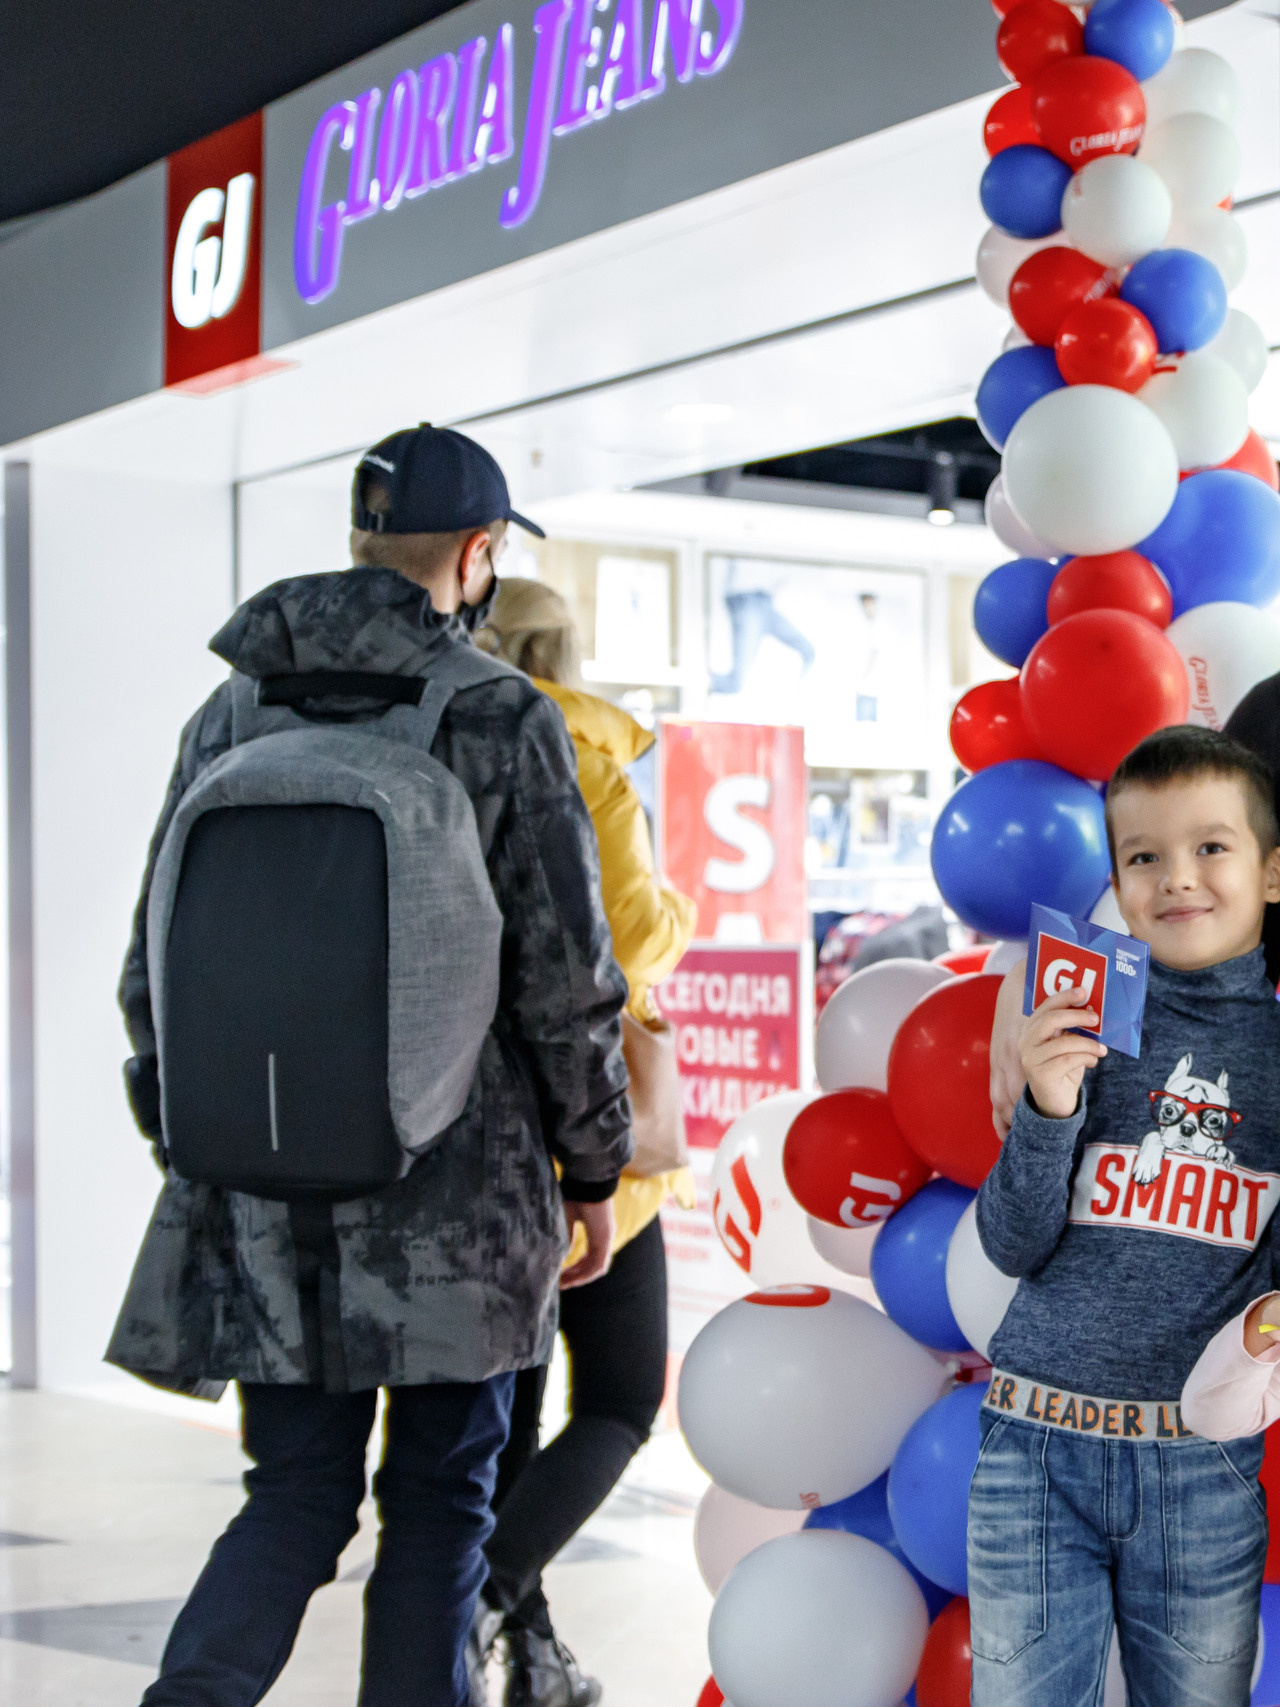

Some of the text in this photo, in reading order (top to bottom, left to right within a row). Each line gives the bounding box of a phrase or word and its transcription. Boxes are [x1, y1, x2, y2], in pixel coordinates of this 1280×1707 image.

[294, 0, 748, 304] GLORIA JEANS
[171, 172, 255, 328] GJ
[703, 774, 776, 943] S
[658, 971, 791, 1021] СЕГОДНЯ
[1042, 958, 1097, 1007] GJ
[679, 1024, 760, 1070] ОВЫЕ
[1091, 1154, 1268, 1242] SMART
[1025, 1386, 1146, 1437] LEADER
